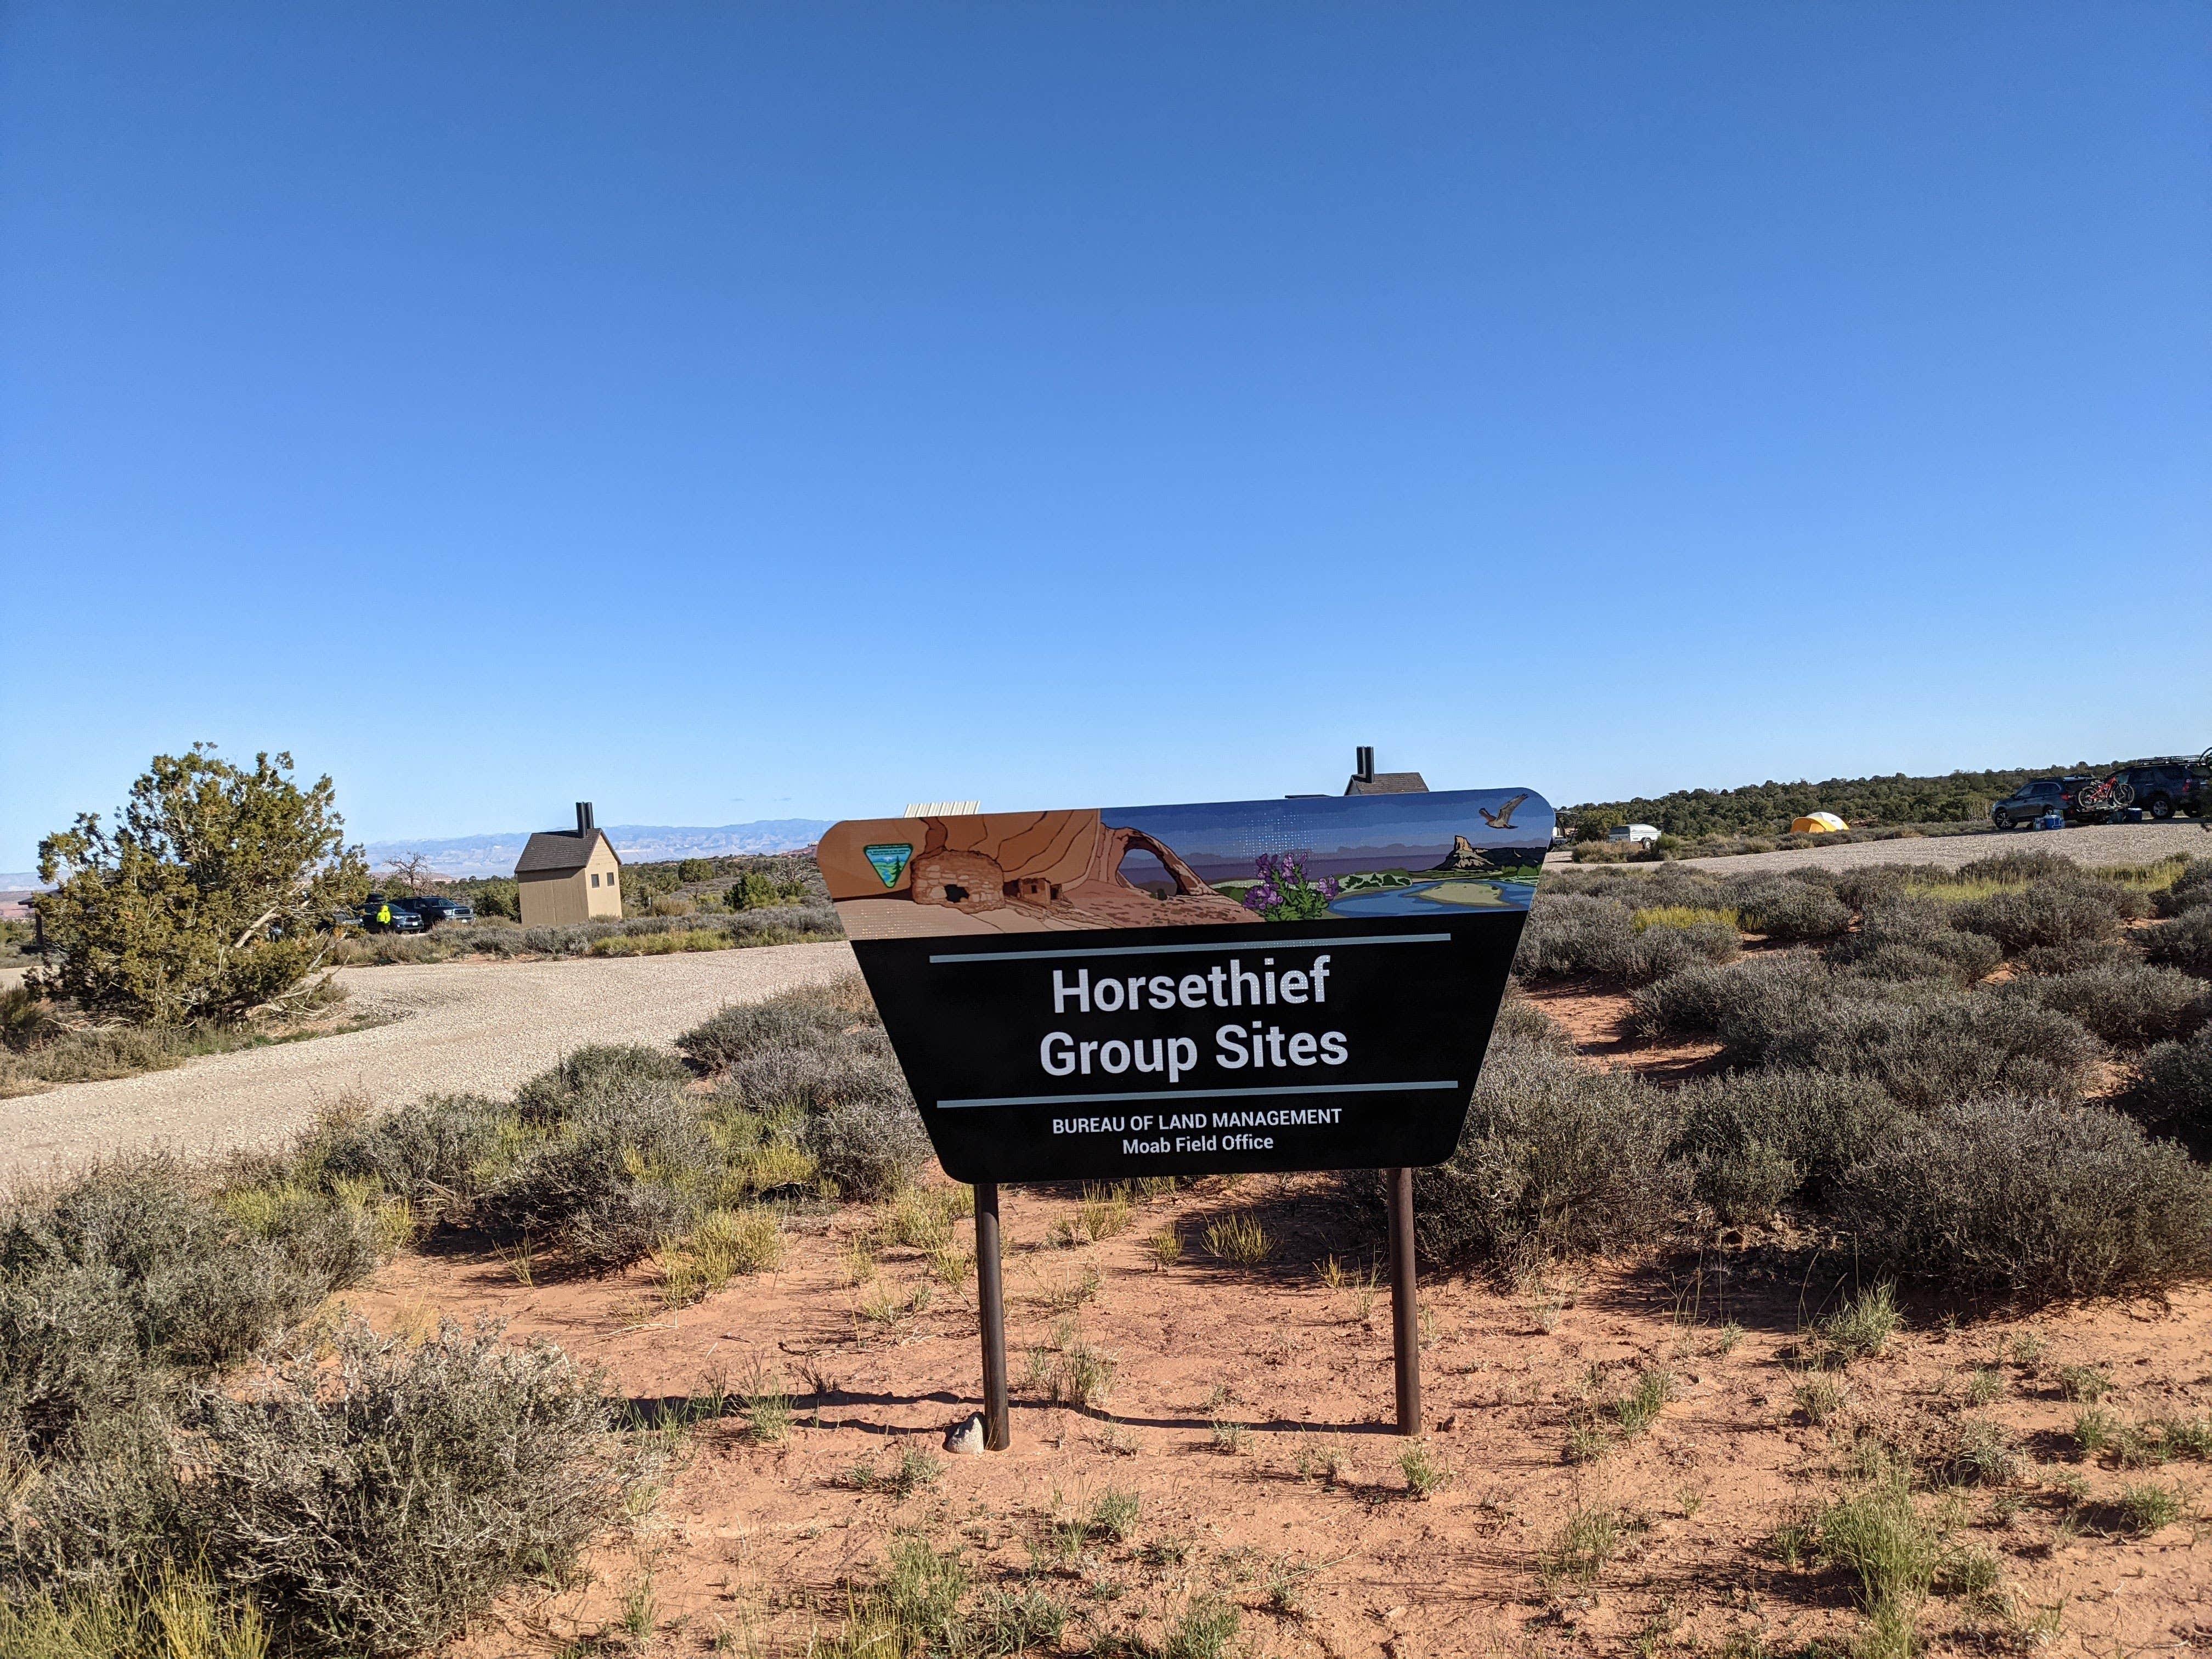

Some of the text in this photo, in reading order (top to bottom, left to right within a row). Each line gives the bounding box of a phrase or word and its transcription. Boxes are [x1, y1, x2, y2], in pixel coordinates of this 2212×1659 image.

[1053, 955, 1331, 1014] Horsethief
[1040, 1020, 1348, 1083] Group Sites
[1053, 1108, 1342, 1134] BUREAU OF LAND MANAGEMENT
[1122, 1133, 1274, 1154] Moab Field Office
